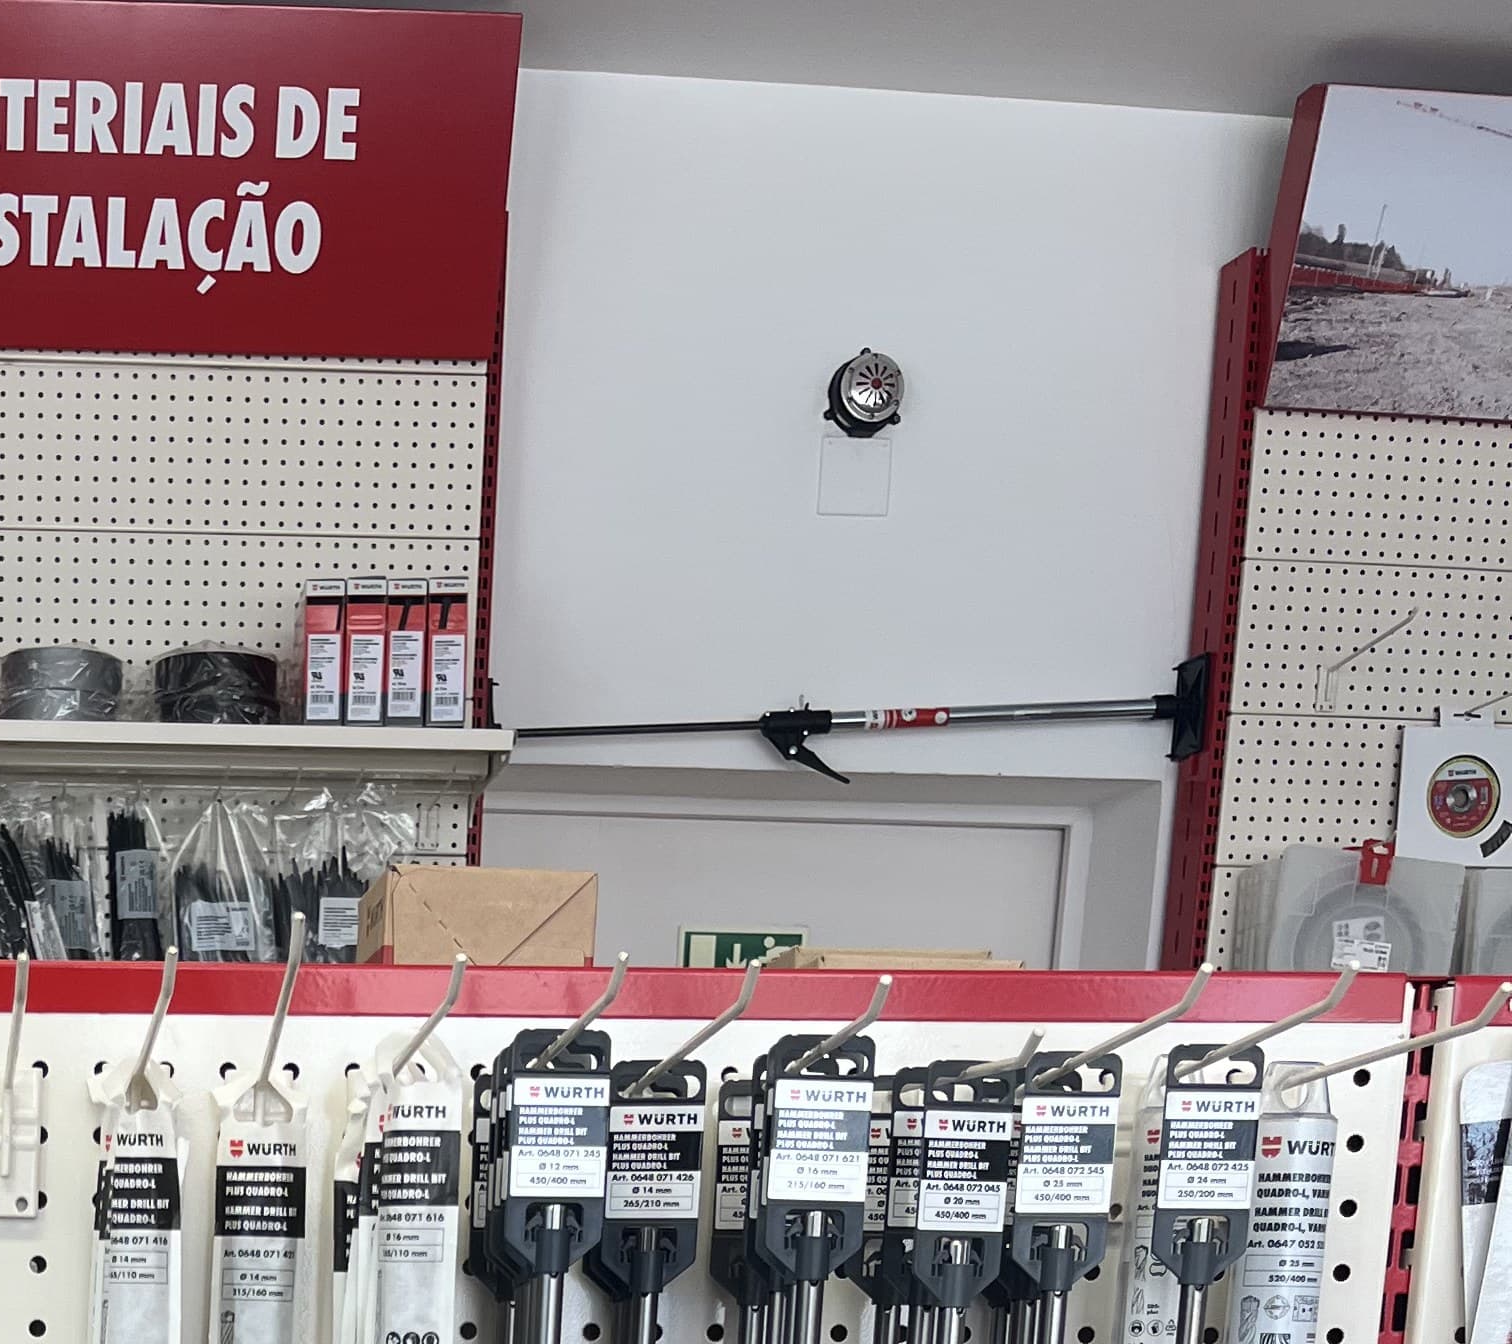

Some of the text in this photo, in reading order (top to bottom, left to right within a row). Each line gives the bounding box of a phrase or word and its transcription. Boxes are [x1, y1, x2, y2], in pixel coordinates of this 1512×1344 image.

[275, 86, 360, 160] DE
[545, 1084, 604, 1098] WÜRTH
[806, 1090, 866, 1104] WÜRTH
[1051, 1104, 1109, 1117] WÜRTH
[1196, 1100, 1255, 1113] WÜRTH
[638, 1113, 697, 1126] WÜRTH
[952, 1120, 1006, 1134] WÜRTH
[613, 1142, 668, 1151] PLUS QUADRO-L
[518, 1149, 601, 1158] Art. 0648 071 245
[613, 1153, 680, 1161] HAMMER DRILL BIT
[776, 1153, 860, 1162] Art. 0648 071 621
[612, 1162, 667, 1171] PLUS QUADRO-L
[1023, 1166, 1105, 1175] Art. 0648 072 545
[1168, 1163, 1249, 1172] Art. 0648 072 425
[612, 1173, 695, 1182] Art. 0648 071 426
[1187, 1176, 1195, 1185] Ø
[1197, 1176, 1208, 1185] 24
[632, 1186, 640, 1195] Ø
[643, 1186, 652, 1195] 14
[926, 1183, 1000, 1193] Art. 0648 072 045
[623, 1200, 660, 1208] 265/210
[944, 1197, 951, 1206] Ø
[953, 1198, 963, 1206] 20
[133, 1236, 168, 1246] 071 416
[1268, 1239, 1315, 1249] 0647 052
